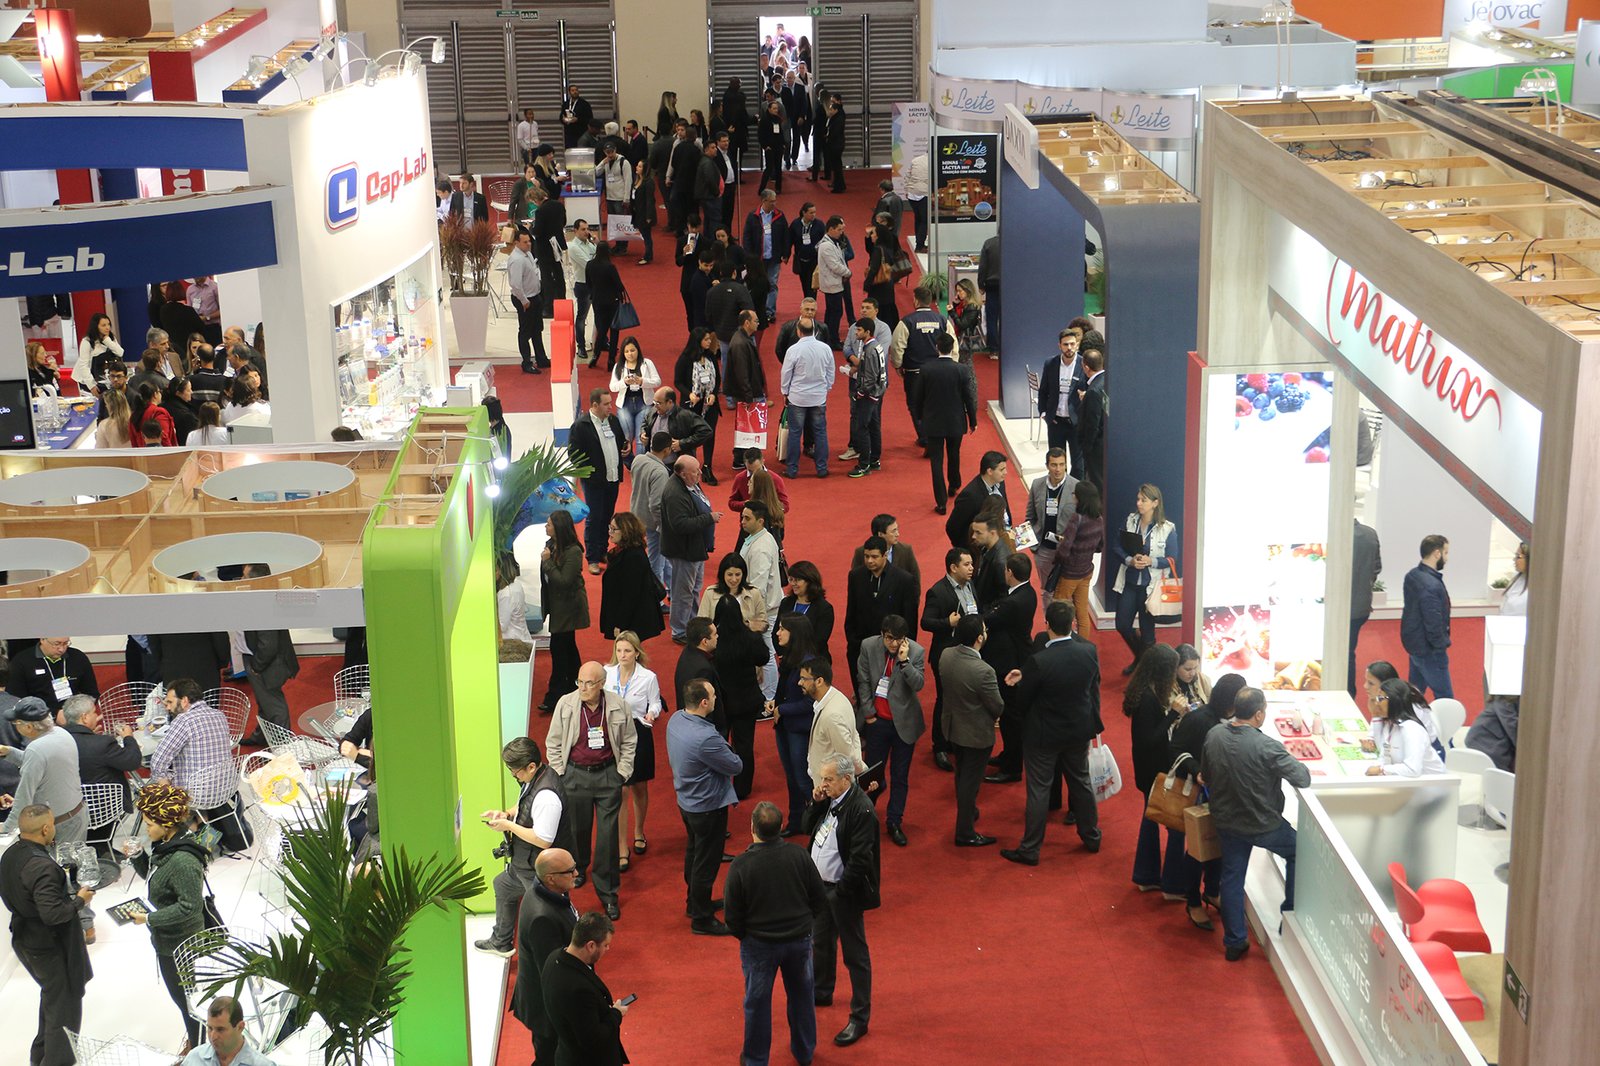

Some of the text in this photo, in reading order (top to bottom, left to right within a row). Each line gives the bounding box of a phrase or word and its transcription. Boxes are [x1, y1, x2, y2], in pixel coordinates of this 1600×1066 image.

[953, 88, 995, 113] Leite
[1124, 104, 1172, 131] Leite
[956, 140, 988, 156] Leite
